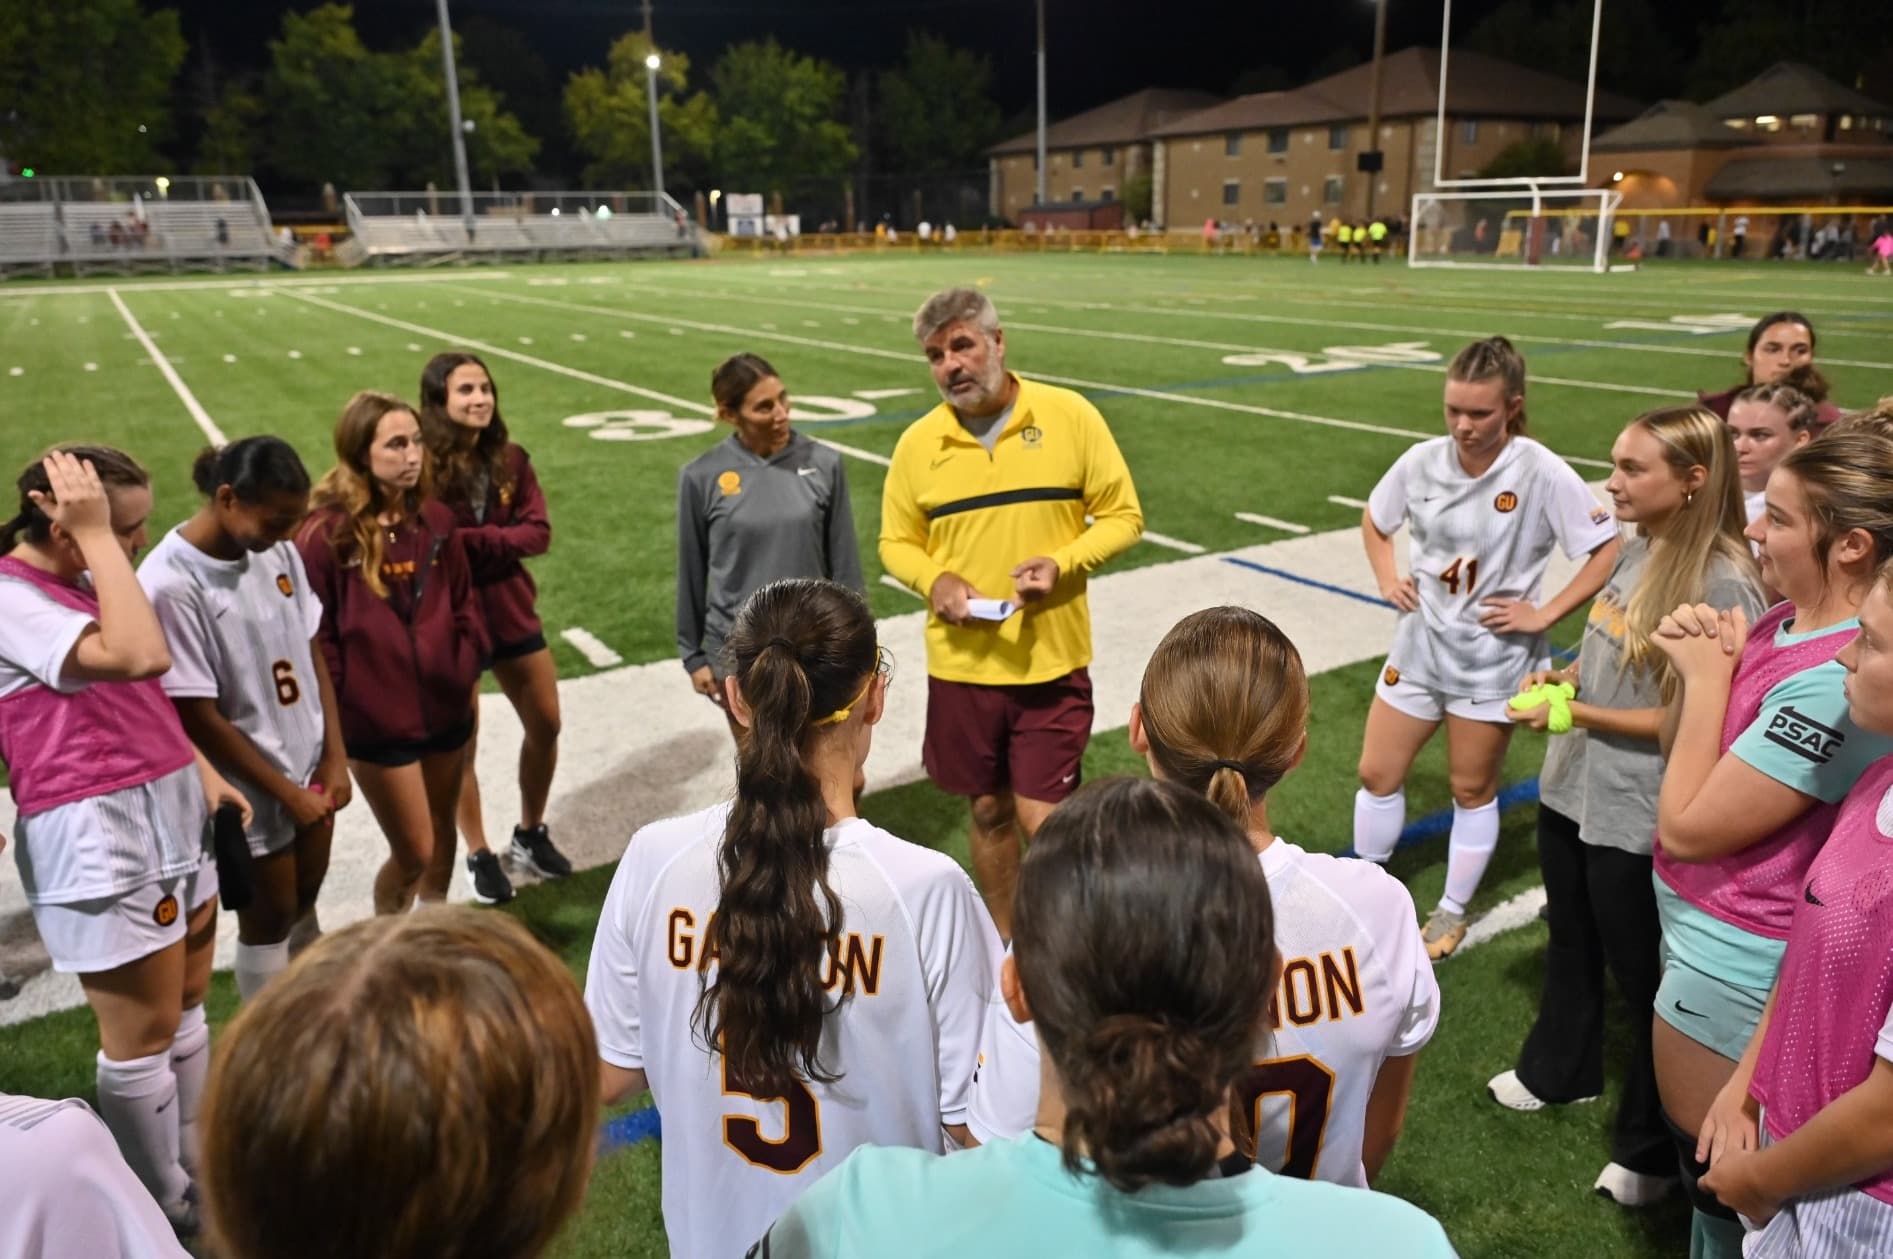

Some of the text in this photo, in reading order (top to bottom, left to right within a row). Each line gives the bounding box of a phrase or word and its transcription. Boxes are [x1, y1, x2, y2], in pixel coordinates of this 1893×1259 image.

[1496, 493, 1516, 511] GU
[1438, 556, 1478, 596] 41
[272, 658, 301, 707] 6
[1768, 713, 1843, 758] PSAC
[719, 1022, 824, 1175] 5
